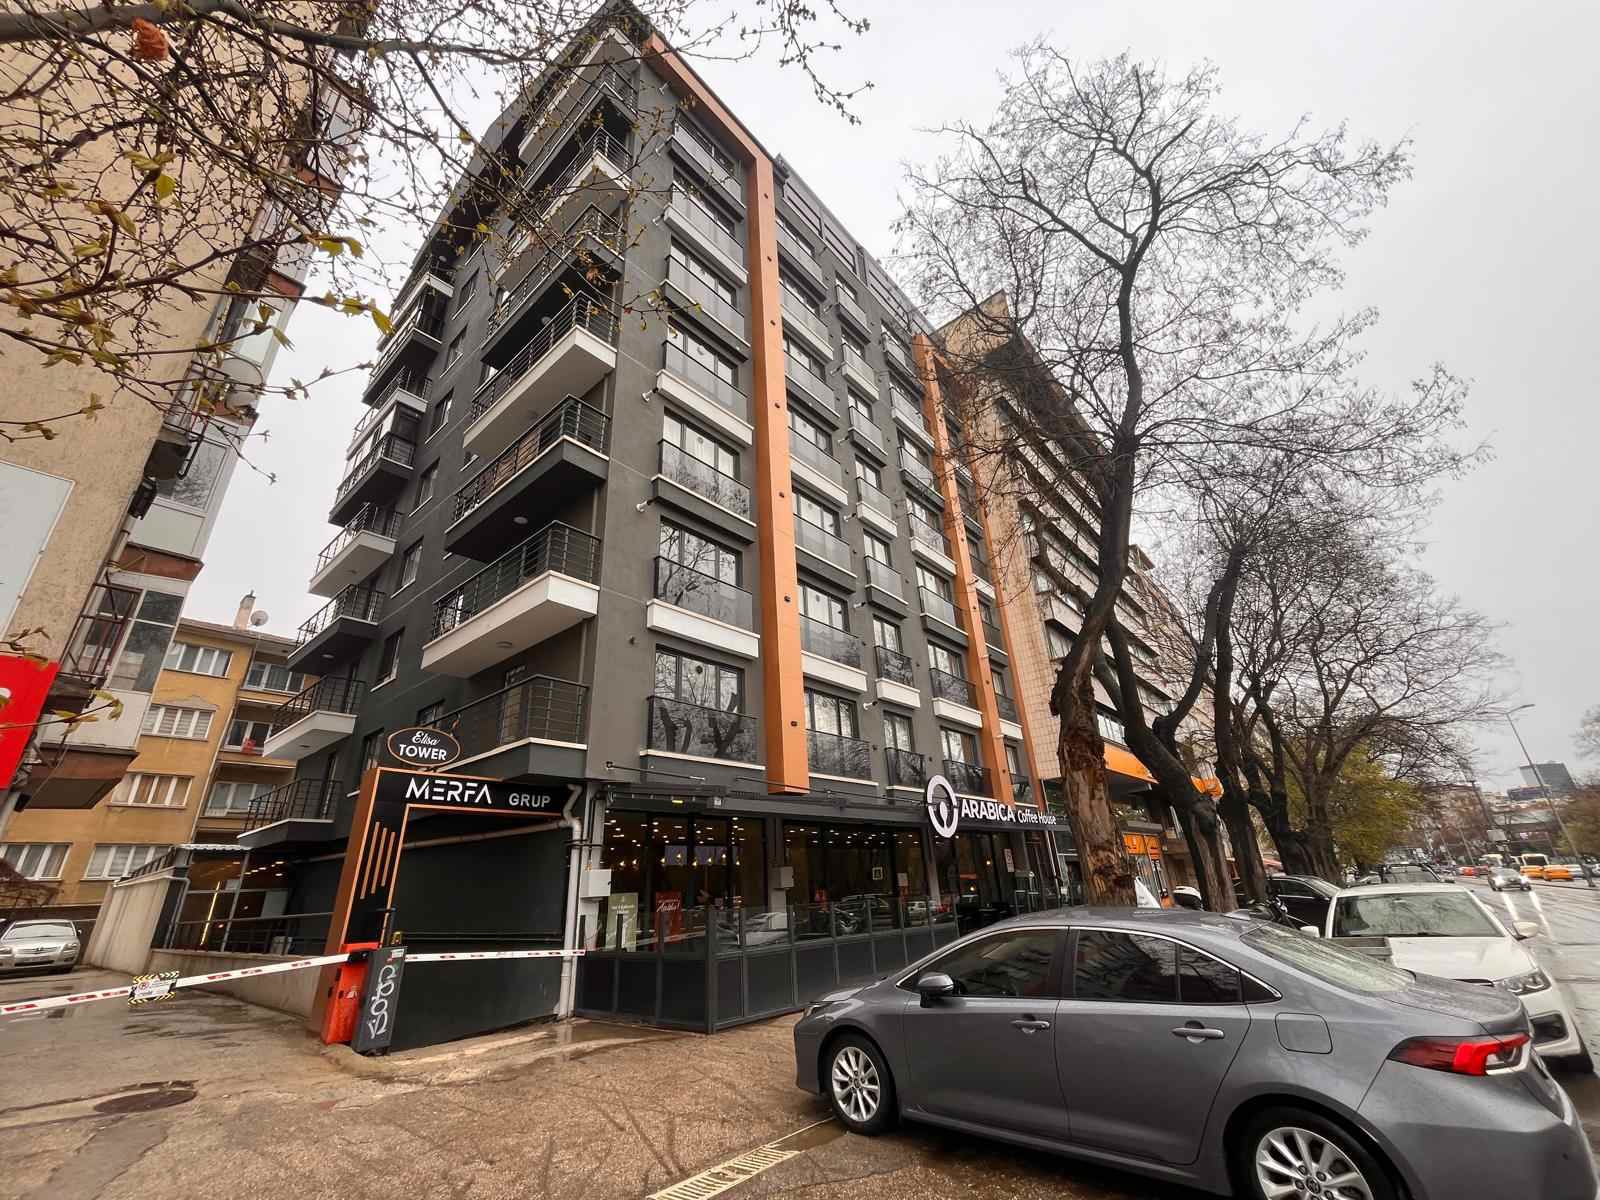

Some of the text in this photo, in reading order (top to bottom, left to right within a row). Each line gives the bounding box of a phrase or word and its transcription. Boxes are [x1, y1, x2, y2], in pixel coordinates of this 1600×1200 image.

[412, 731, 440, 746] Elisa
[399, 744, 447, 761] TOWER
[405, 777, 551, 808] MERFA GRUP
[961, 799, 1057, 825] ARABICA Coffee House
